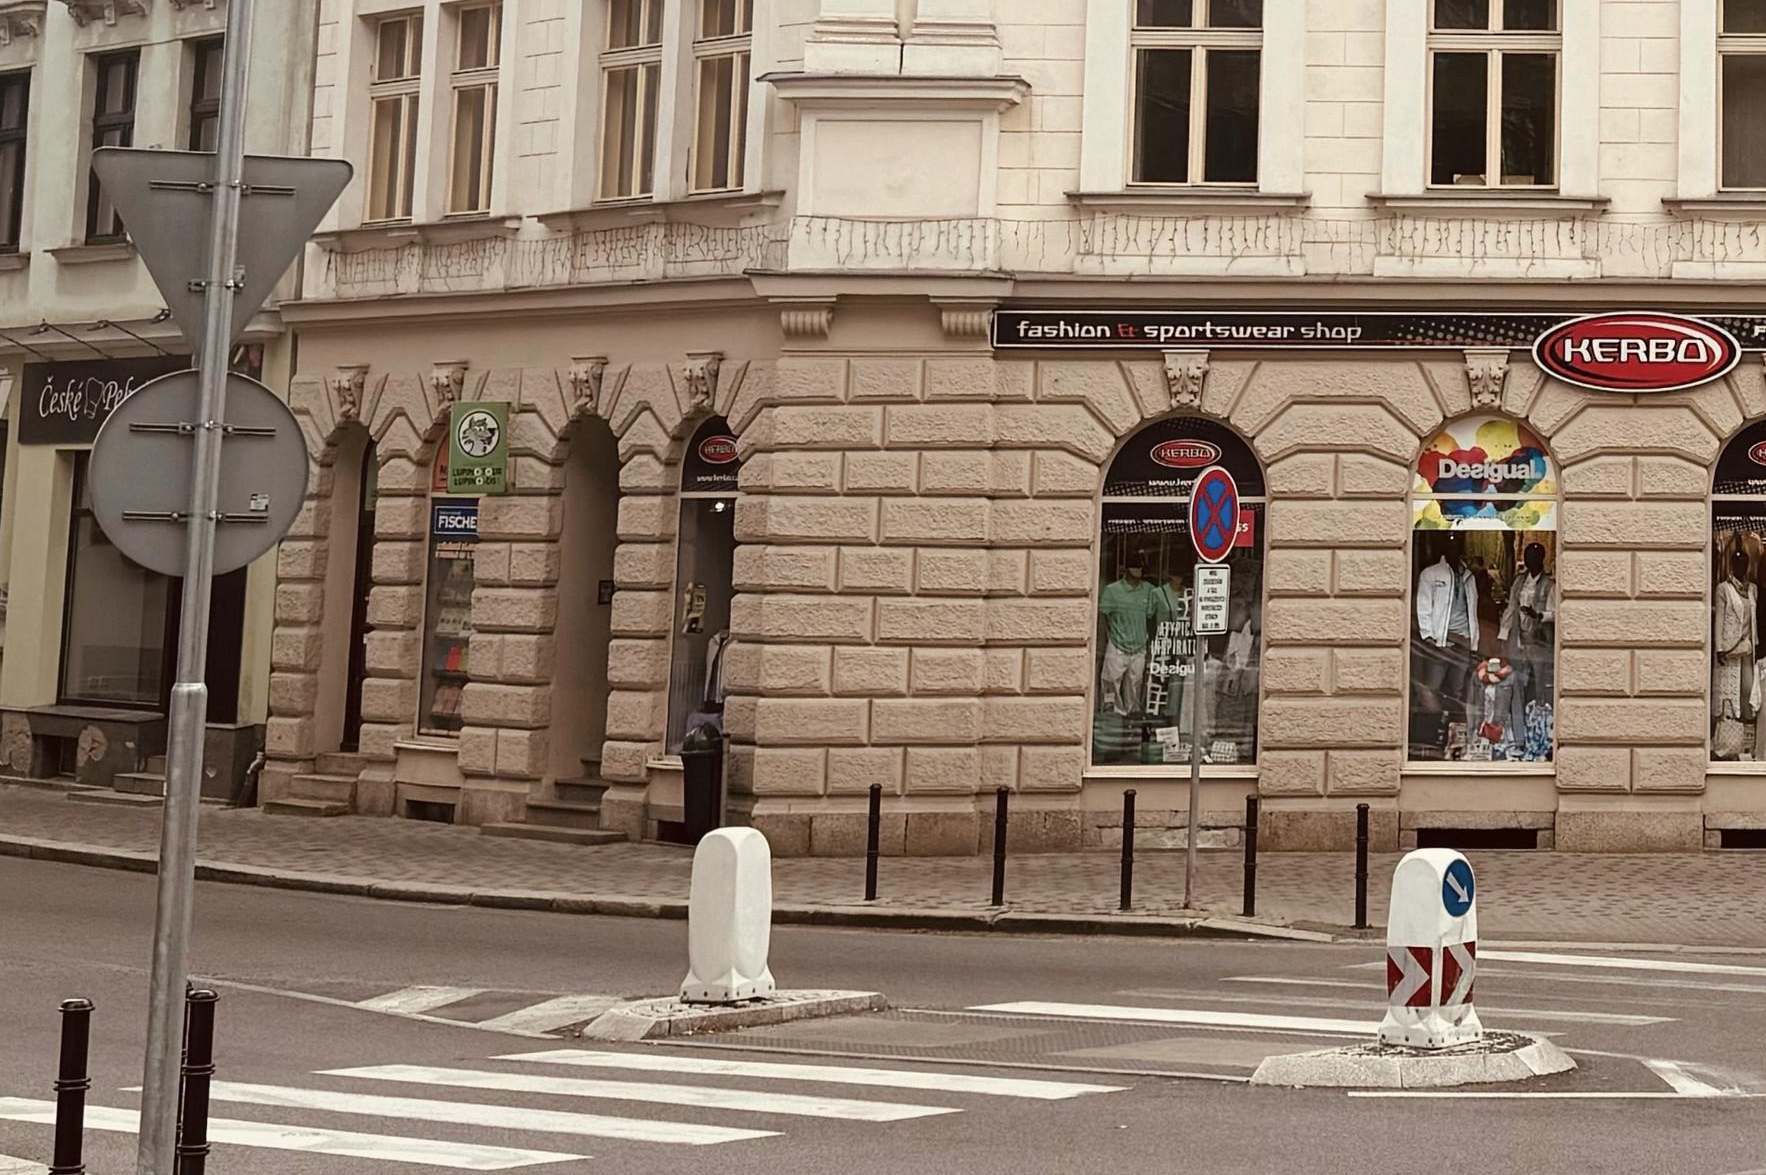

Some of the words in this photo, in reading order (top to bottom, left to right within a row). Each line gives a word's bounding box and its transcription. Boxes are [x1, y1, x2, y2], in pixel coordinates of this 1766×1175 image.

[1016, 321, 1111, 338] fashion
[1144, 321, 1296, 343] sportswear
[1300, 321, 1362, 344] shop
[1563, 338, 1710, 363] KERBO
[39, 376, 84, 421] České
[438, 515, 478, 529] FISCHE
[1150, 660, 1207, 676] Desigul
